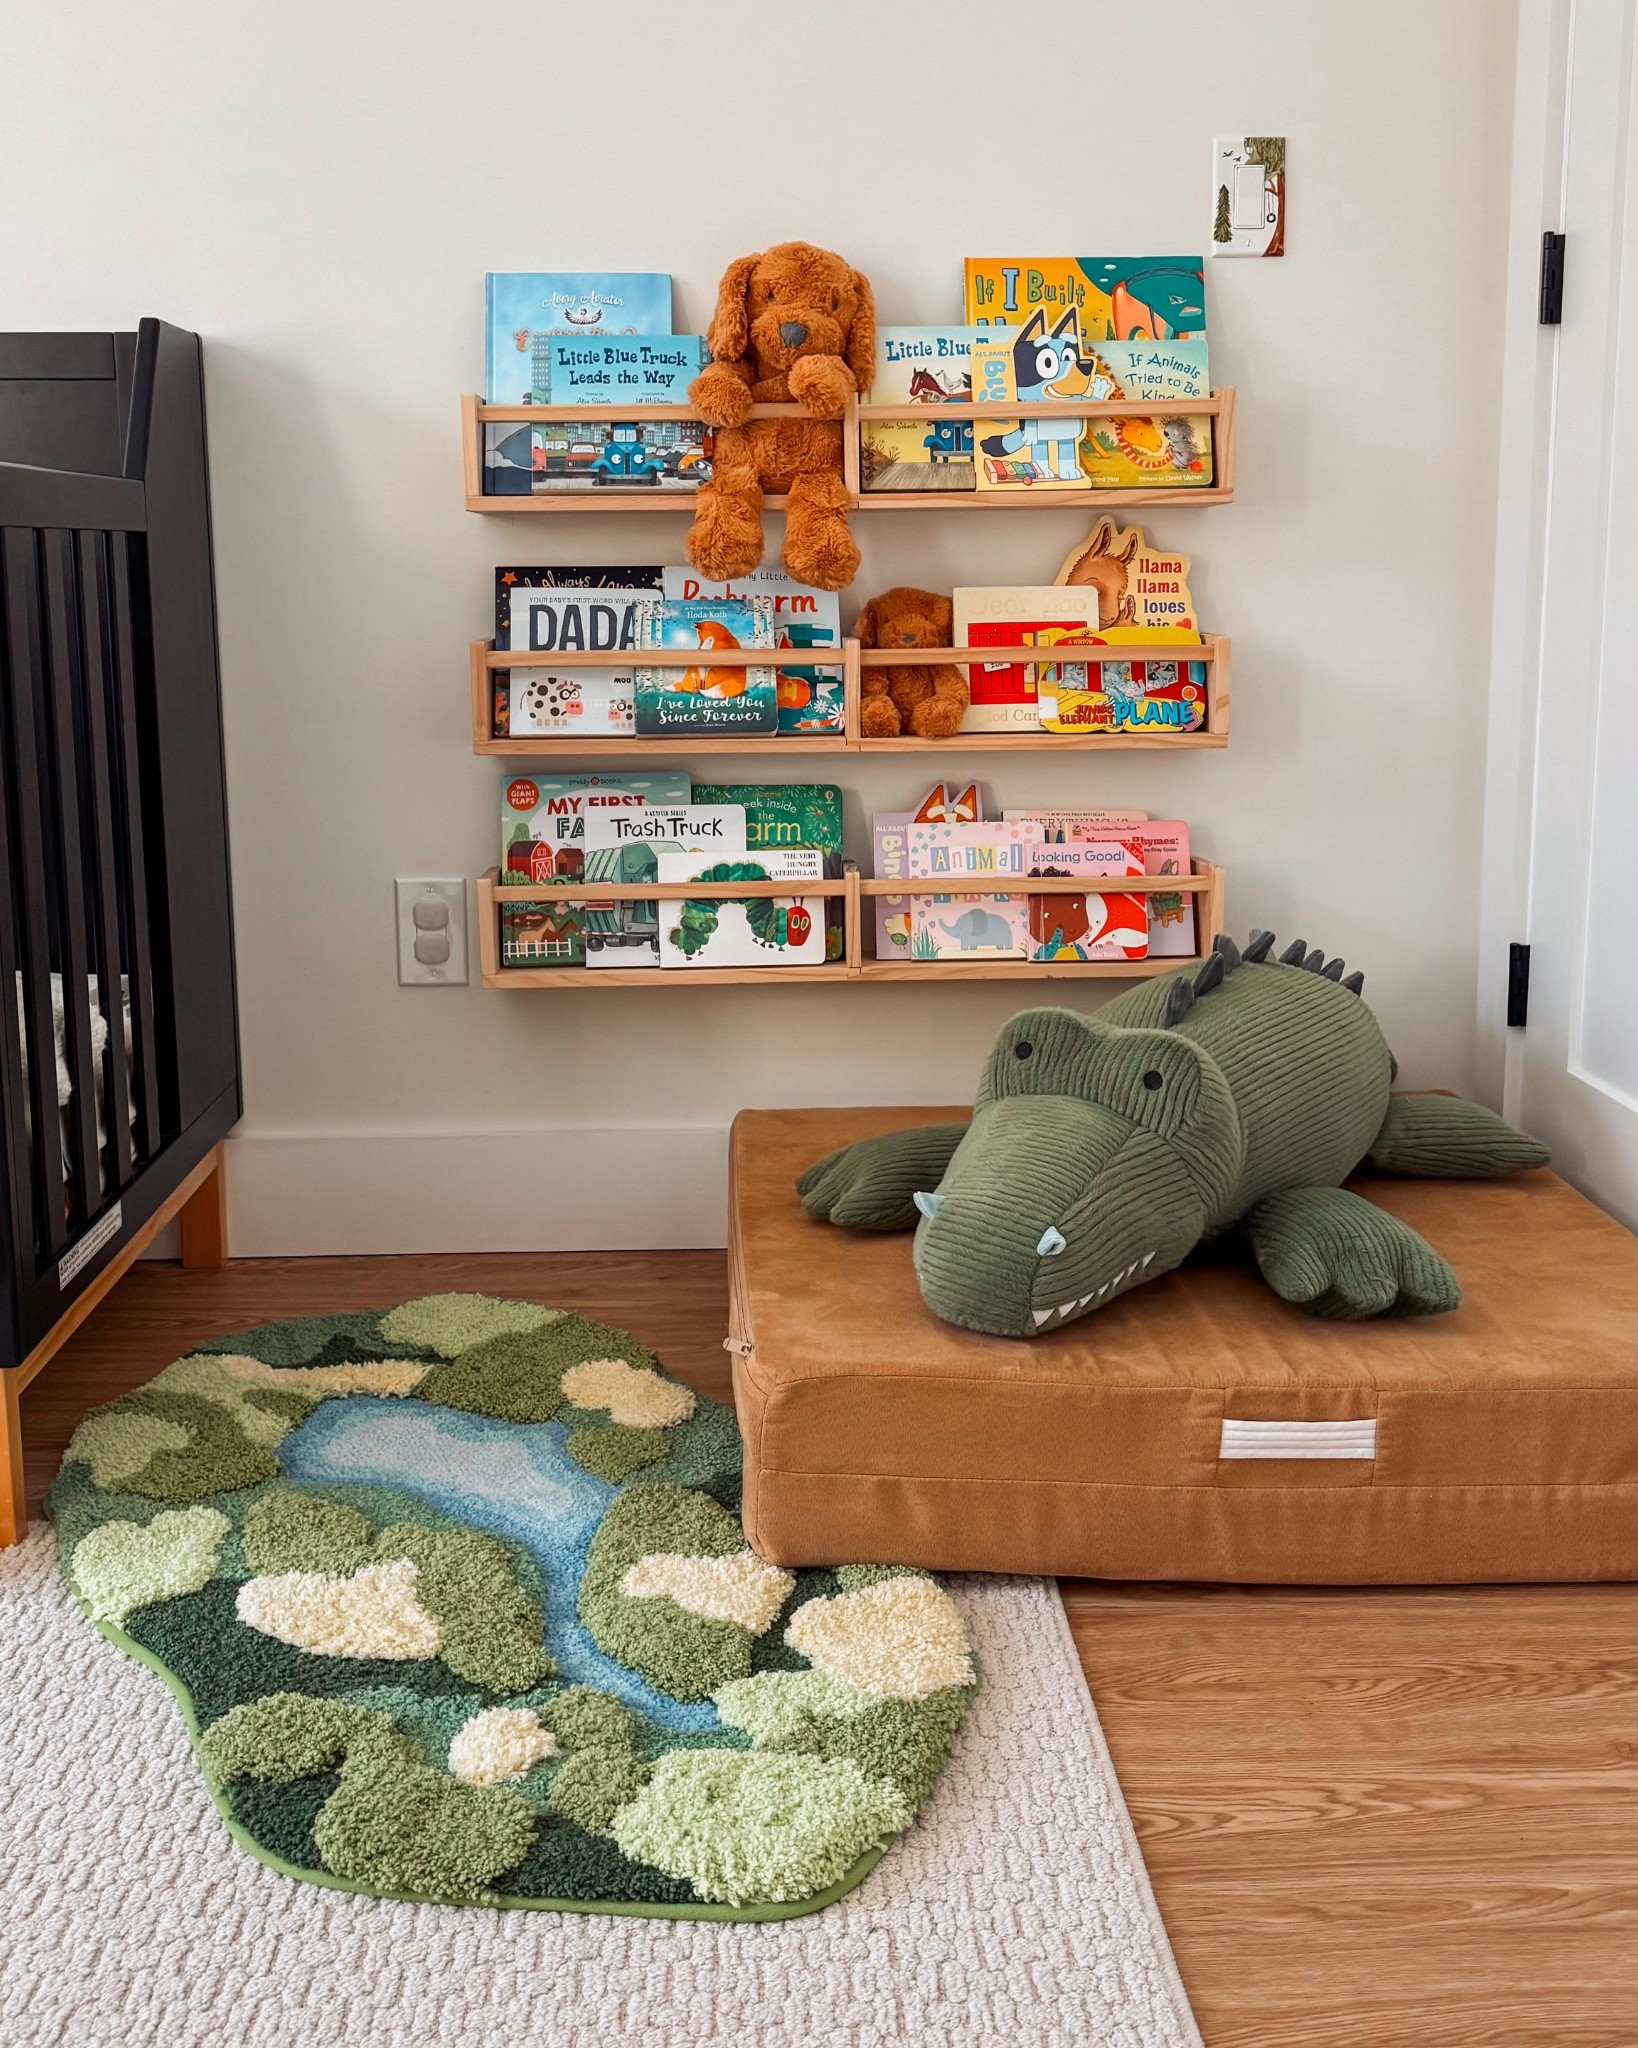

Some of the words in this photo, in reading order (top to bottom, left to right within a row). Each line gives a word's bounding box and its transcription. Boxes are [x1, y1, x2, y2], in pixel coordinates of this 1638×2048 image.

[975, 274, 995, 305] If
[1002, 267, 1020, 311] I
[1027, 269, 1086, 307] Built
[580, 290, 625, 307] Aviator
[558, 347, 600, 366] Little
[603, 347, 638, 365] Blue
[639, 346, 688, 366] Truck
[885, 340, 933, 361] Little
[936, 337, 971, 357] Blue
[1128, 353, 1143, 367] If
[1147, 353, 1201, 379] Animals
[569, 369, 611, 385] Leads
[617, 369, 639, 384] the
[643, 370, 675, 388] Way
[1125, 373, 1163, 387] Tried
[1167, 377, 1182, 387] to
[1183, 381, 1201, 397] Be
[1139, 558, 1182, 573] llama
[760, 572, 788, 581] Little
[1137, 578, 1180, 593] llama
[1143, 598, 1186, 613] loves
[687, 610, 707, 619] Hoda
[709, 610, 728, 618] Kotb
[529, 604, 635, 650] DADA
[656, 697, 684, 710] I've
[689, 696, 730, 709] Loved
[736, 696, 765, 709] You
[1074, 704, 1114, 715] JUMBO
[659, 710, 698, 725] Since
[702, 709, 761, 723] Forever
[1059, 714, 1115, 725] ELEPHANT
[1115, 700, 1194, 726] PLANE
[511, 790, 535, 798] GIANT
[512, 797, 535, 805] FLAPS
[547, 797, 582, 815] MY
[766, 798, 797, 813] inside
[758, 810, 775, 820] the
[610, 818, 665, 838] Trash
[666, 817, 723, 837] Truck
[1032, 850, 1081, 863] Looking
[1085, 850, 1125, 862] Good!
